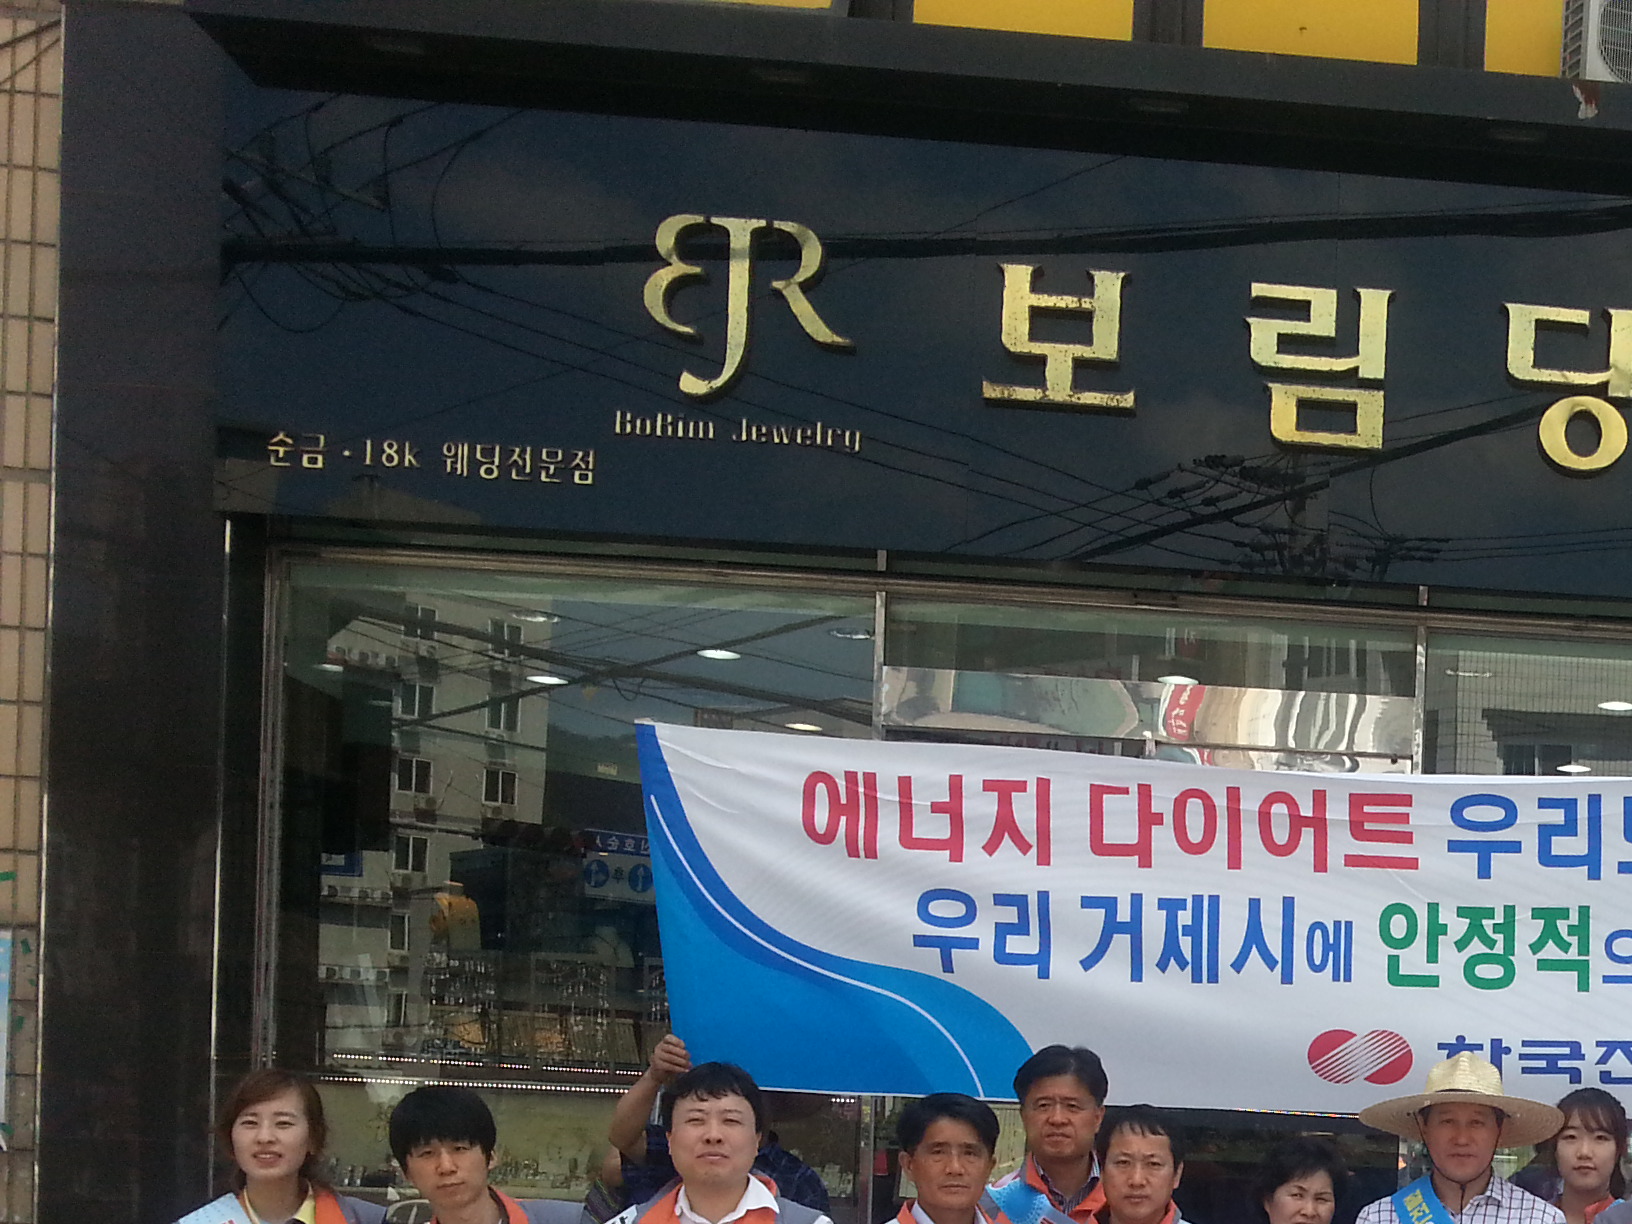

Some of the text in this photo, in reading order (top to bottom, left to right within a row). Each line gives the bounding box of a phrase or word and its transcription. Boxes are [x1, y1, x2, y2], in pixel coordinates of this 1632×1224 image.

[267, 431, 325, 469] 순금
[442, 440, 596, 485] 웨딩전문점
[732, 418, 861, 453] Jewelry
[801, 769, 1053, 867] 에너지
[1088, 781, 1420, 874] 다이어트
[912, 887, 1052, 981] 우리
[1079, 891, 1354, 985] 거제시에
